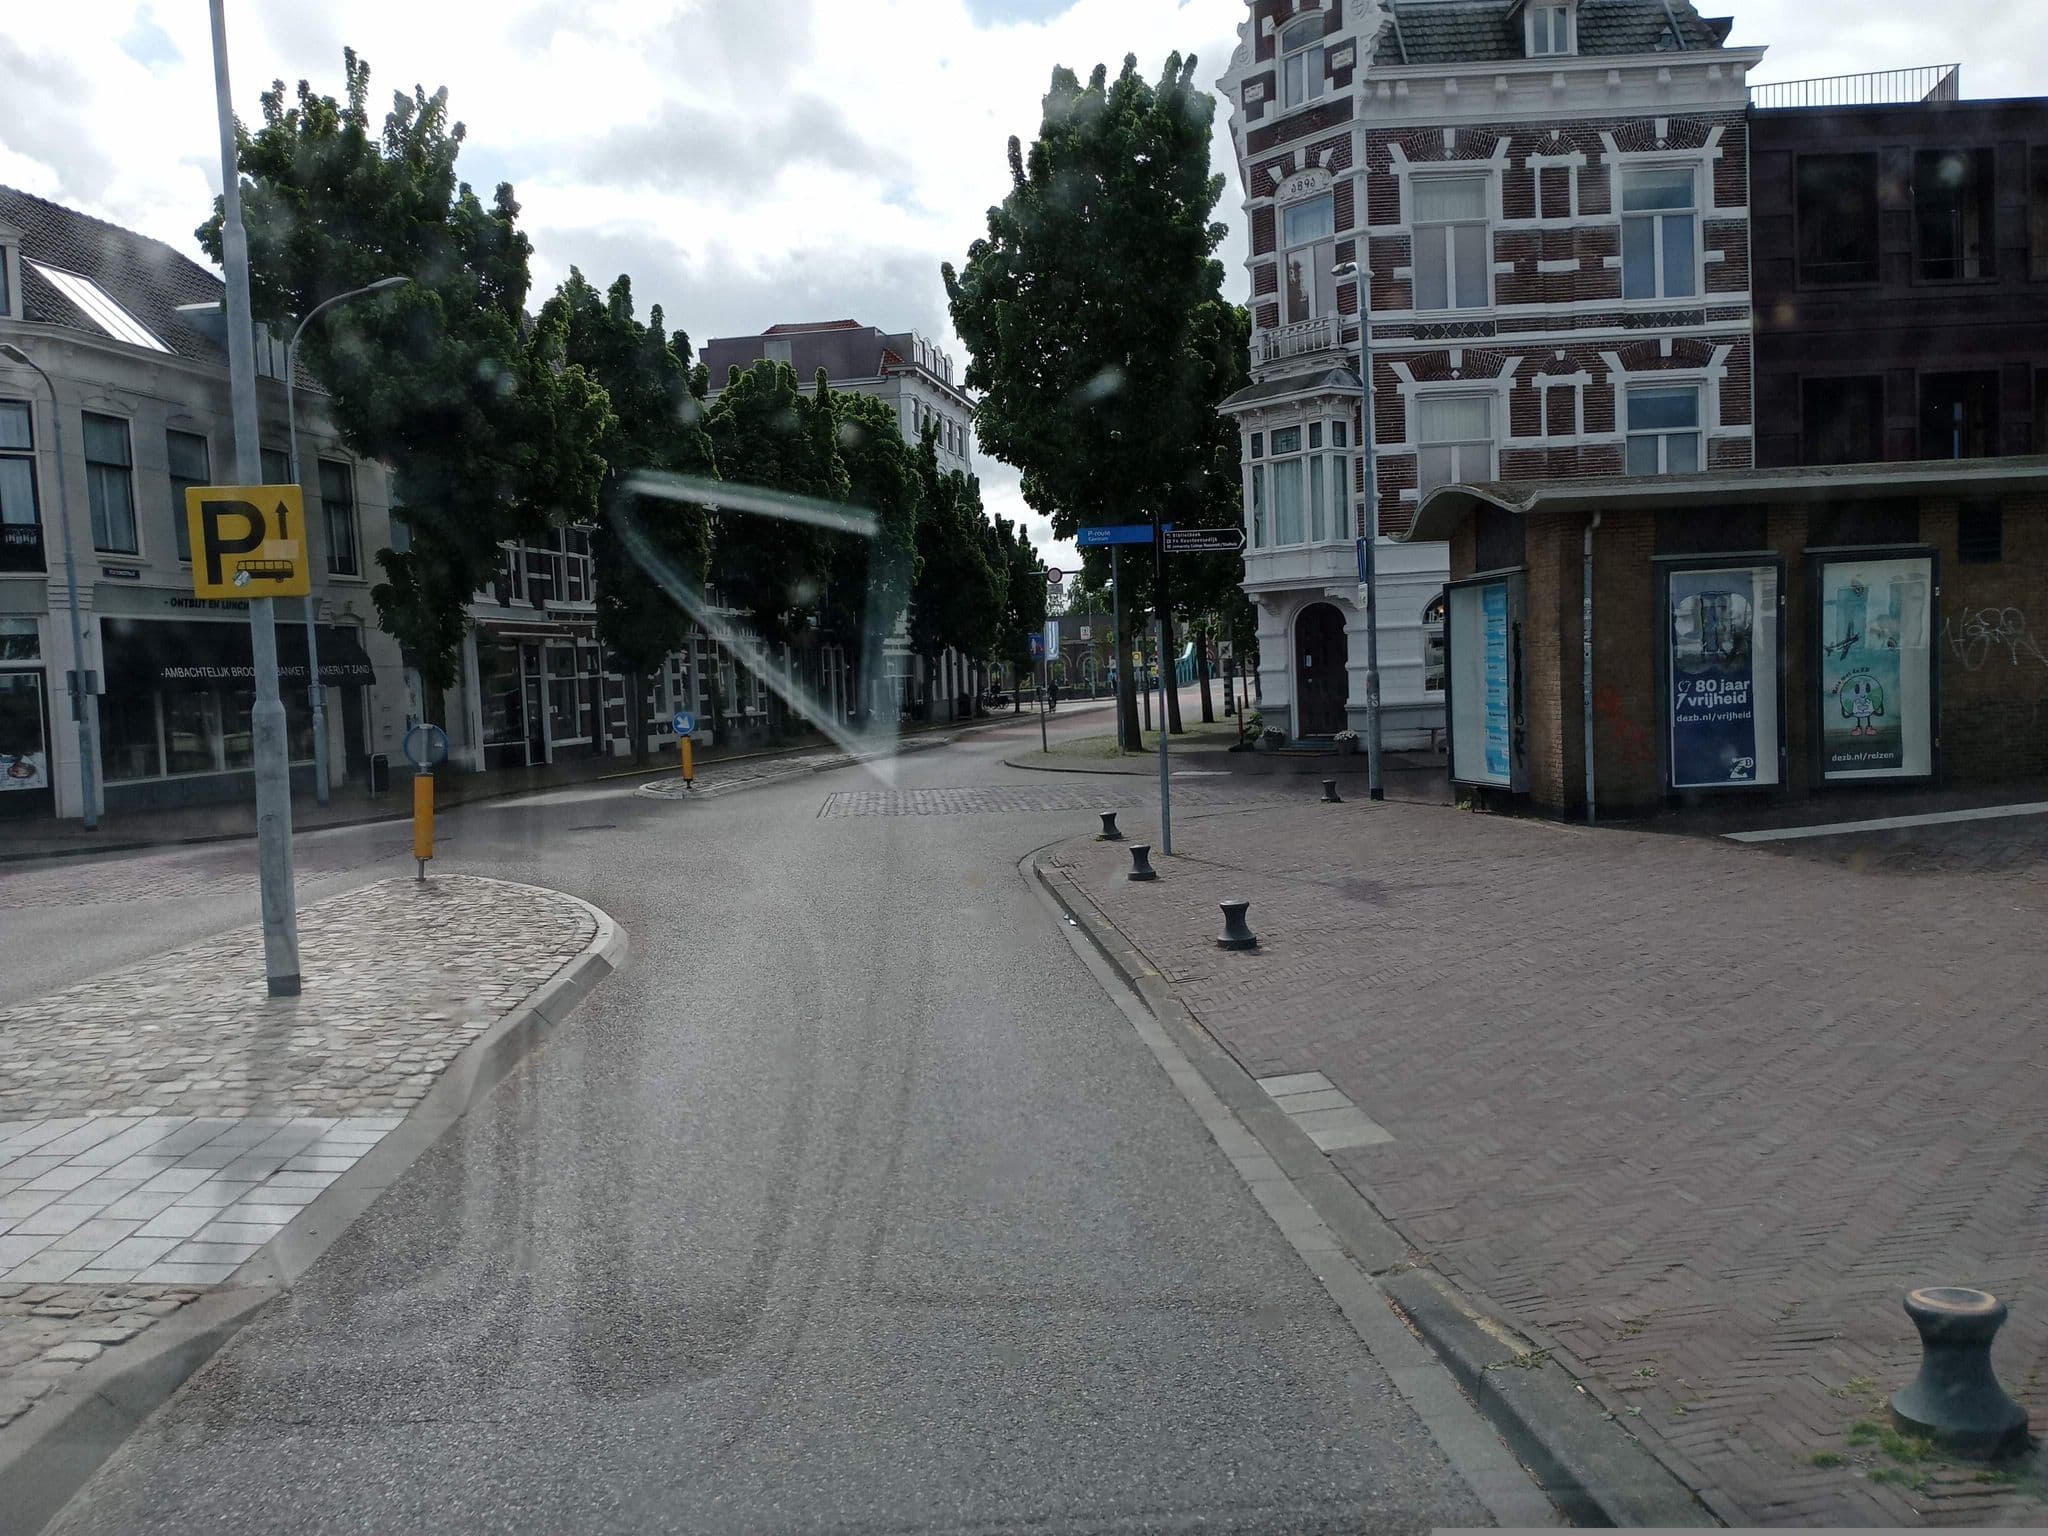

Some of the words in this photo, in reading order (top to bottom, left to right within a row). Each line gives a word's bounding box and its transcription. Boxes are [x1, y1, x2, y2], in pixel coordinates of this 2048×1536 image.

[201, 500, 266, 585] P
[231, 667, 256, 677] BROO
[1695, 679, 1717, 693] 80
[1719, 679, 1751, 694] jaar
[1687, 691, 1747, 708] vrijheid
[1676, 711, 1752, 723] dezb.nl/vrijheid
[1831, 752, 1895, 763] dezb.nl/reizen
